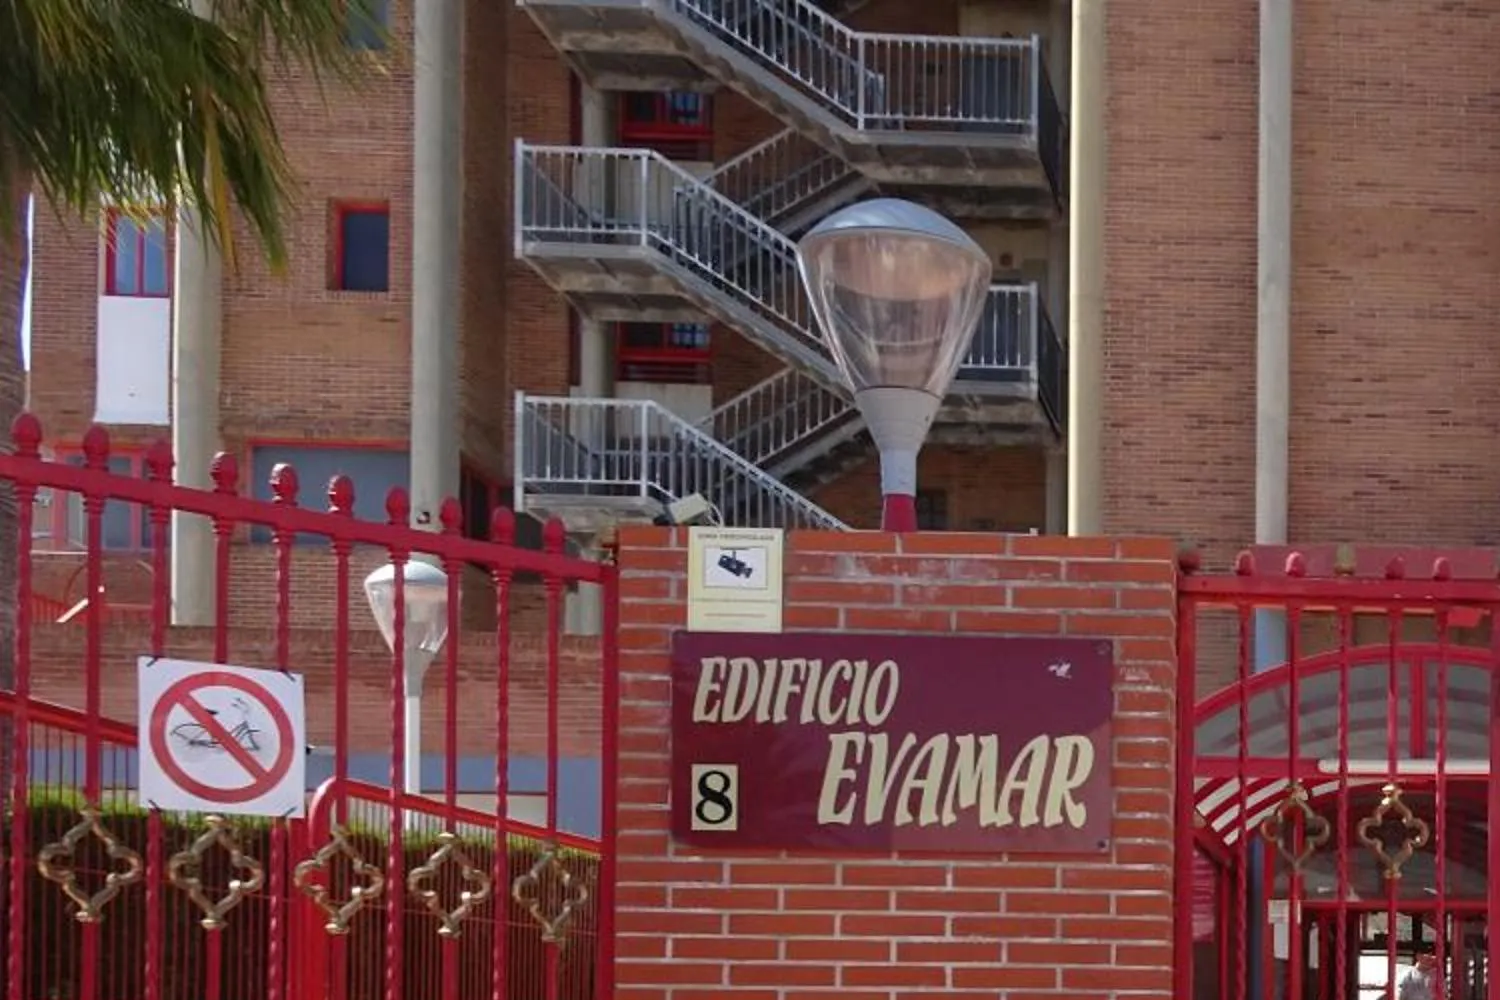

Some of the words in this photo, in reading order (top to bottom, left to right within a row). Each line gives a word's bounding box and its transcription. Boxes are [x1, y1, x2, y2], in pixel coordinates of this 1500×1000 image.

[693, 656, 899, 726] EDIFICIO
[696, 769, 733, 825] 8
[817, 731, 1095, 829] EVAMAR
